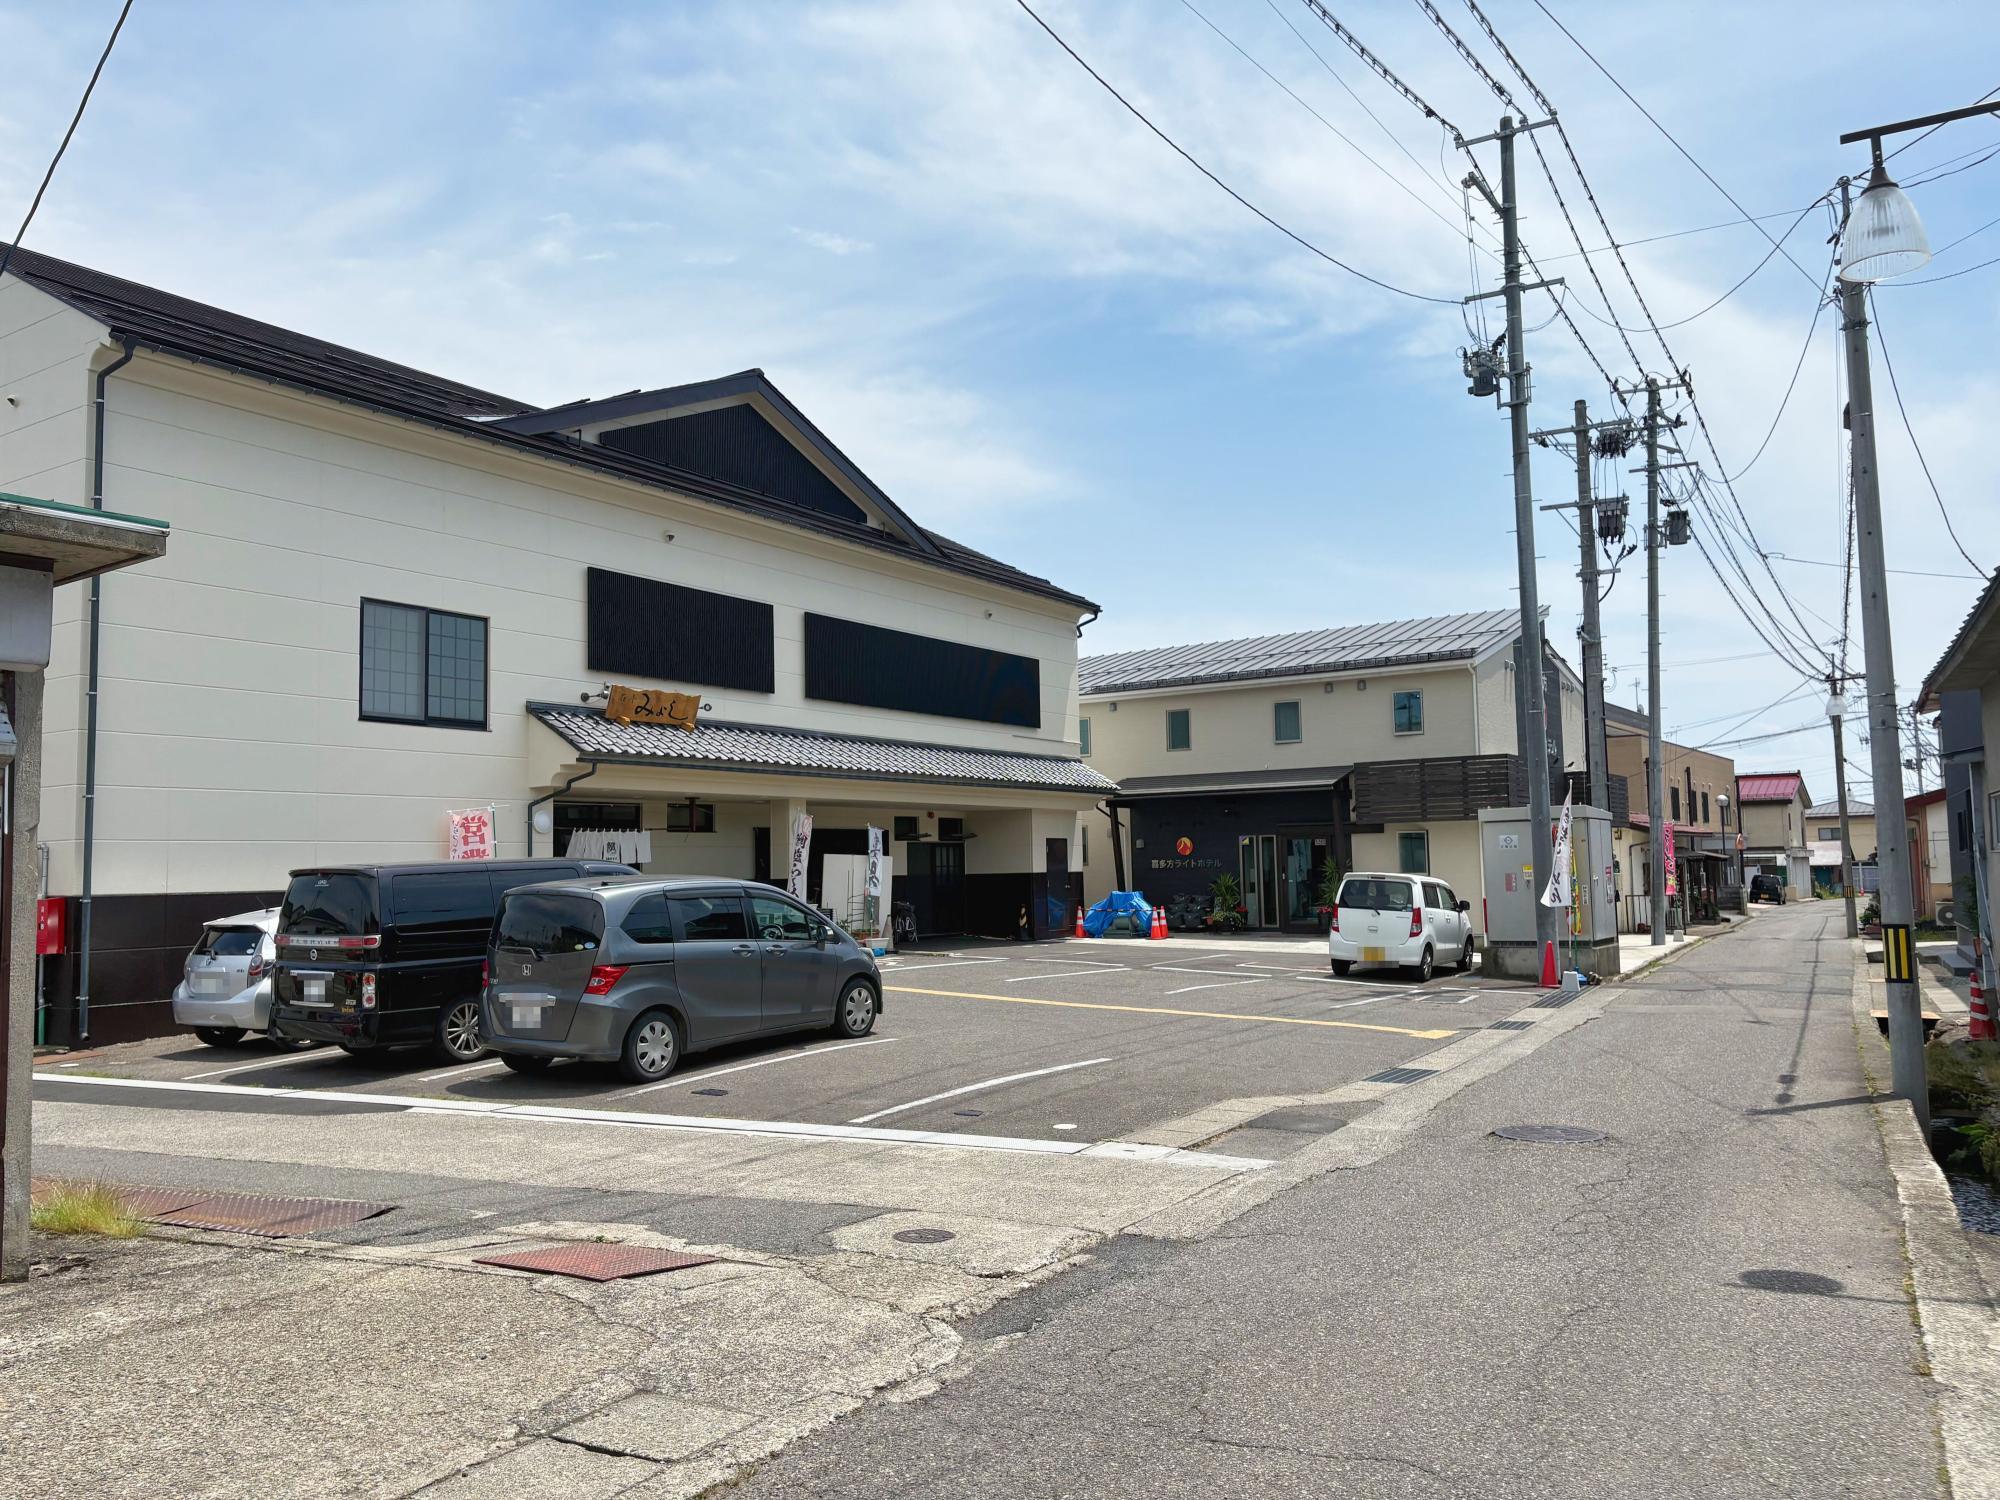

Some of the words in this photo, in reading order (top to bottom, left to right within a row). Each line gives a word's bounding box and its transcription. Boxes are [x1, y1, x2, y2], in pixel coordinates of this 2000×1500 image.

[634, 693, 689, 720] みよし
[1151, 858, 1223, 869] 喜多方ライトホテル
